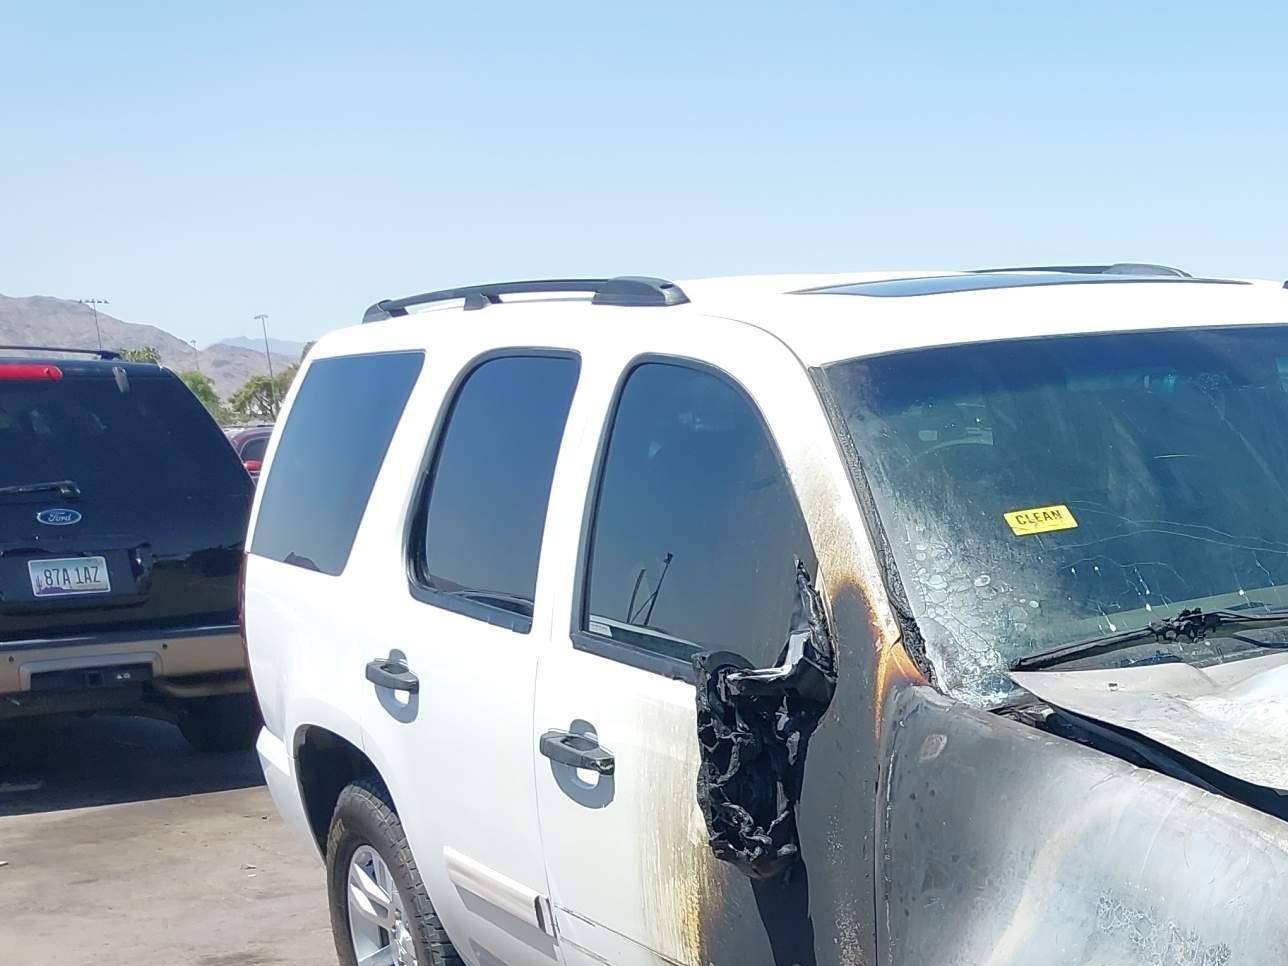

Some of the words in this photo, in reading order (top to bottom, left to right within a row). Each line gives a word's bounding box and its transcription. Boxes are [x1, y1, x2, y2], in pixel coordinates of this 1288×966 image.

[1015, 510, 1063, 525] CLEAN
[44, 567, 72, 586] 87A
[75, 566, 101, 584] 1AZ
